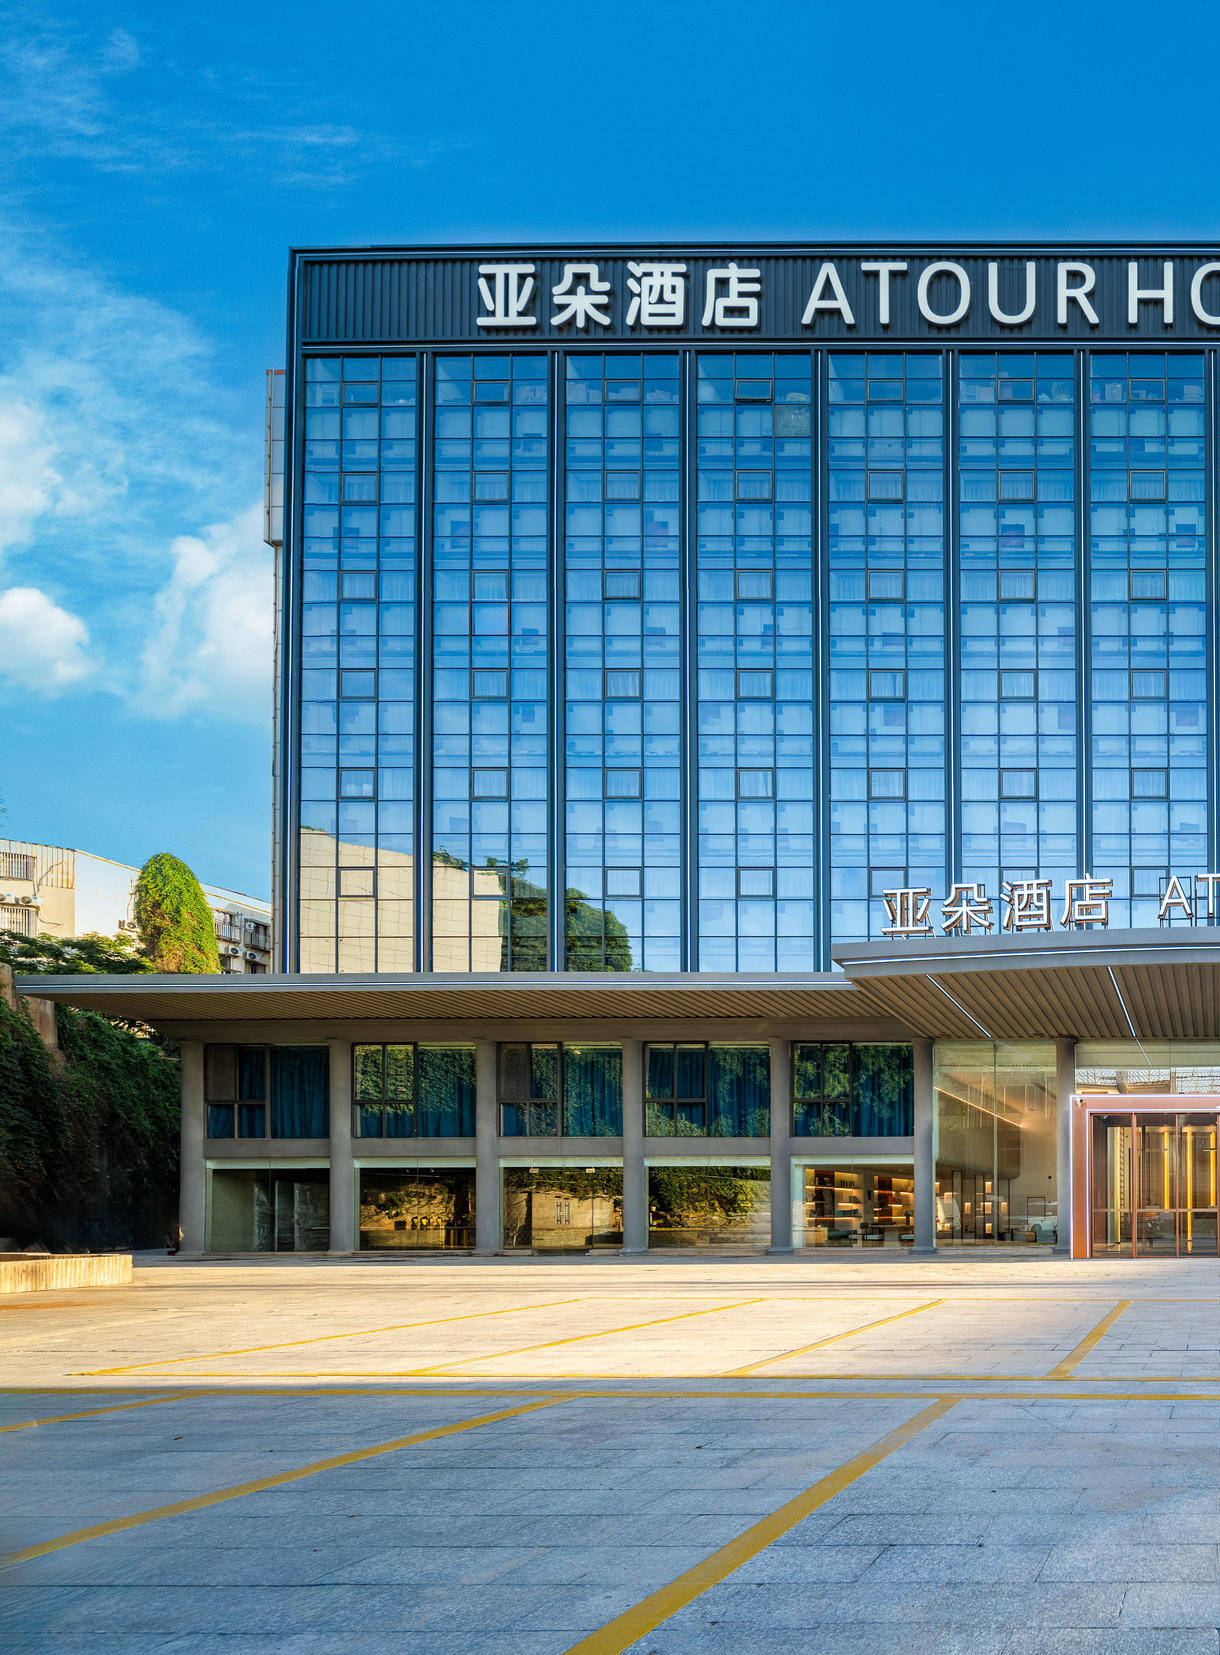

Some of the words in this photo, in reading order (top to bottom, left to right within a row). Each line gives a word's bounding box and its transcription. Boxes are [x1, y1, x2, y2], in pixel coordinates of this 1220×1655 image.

[475, 261, 762, 329] 亚朵酒店
[801, 261, 1100, 328] ATOUR
[881, 874, 1114, 936] 亚朵酒店
